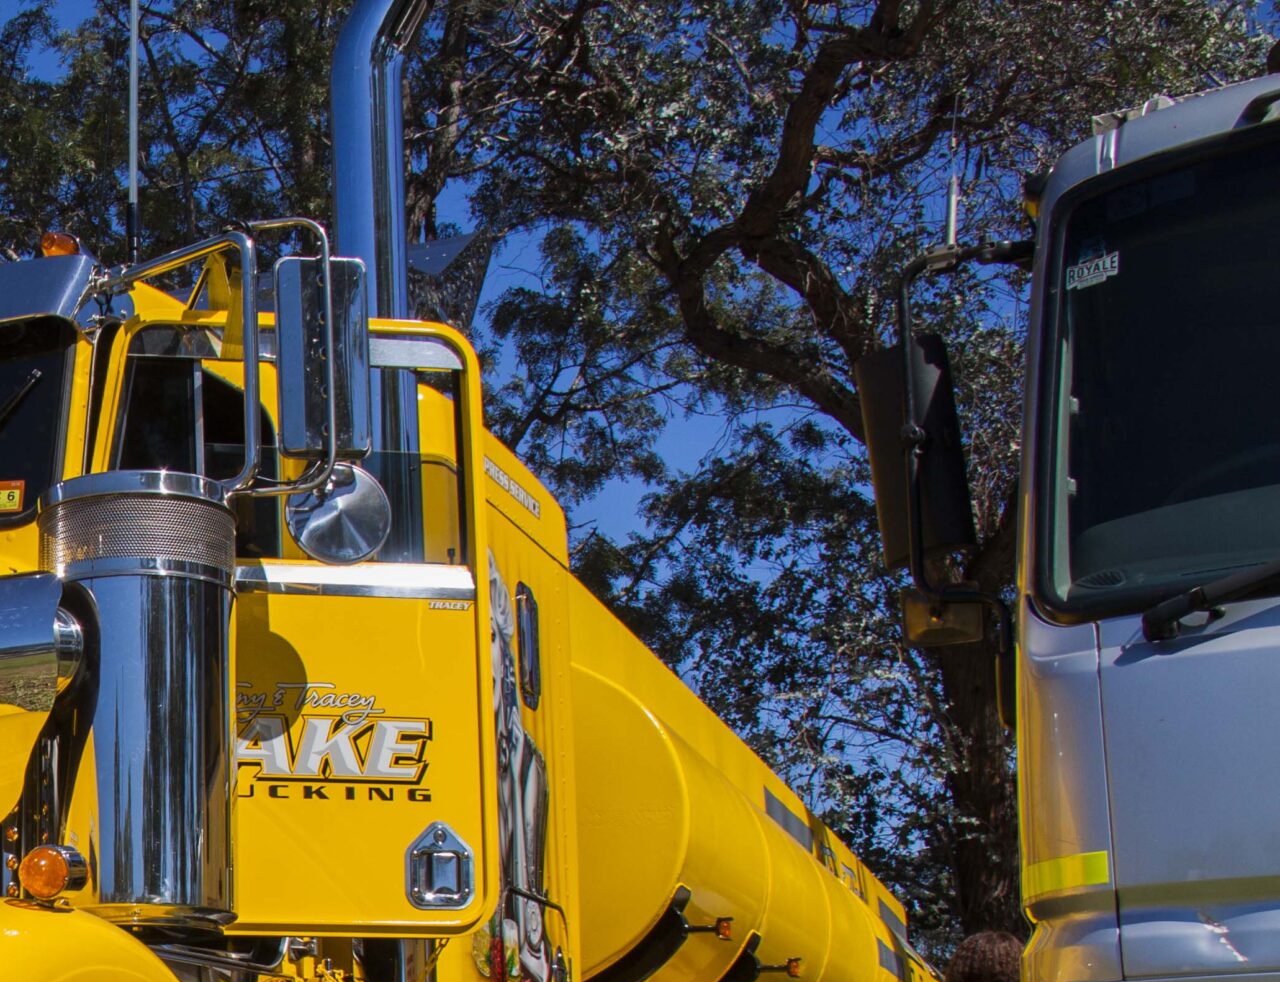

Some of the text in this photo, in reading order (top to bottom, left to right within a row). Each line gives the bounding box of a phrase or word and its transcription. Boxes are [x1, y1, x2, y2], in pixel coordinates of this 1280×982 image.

[1067, 254, 1118, 284] ROYALE
[7, 491, 16, 501] 6
[484, 455, 540, 520] PRESS SERVICE
[429, 602, 473, 611] TRACEY
[277, 682, 385, 726] Tracey
[236, 714, 432, 784] AKE
[237, 784, 432, 802] UCKING
